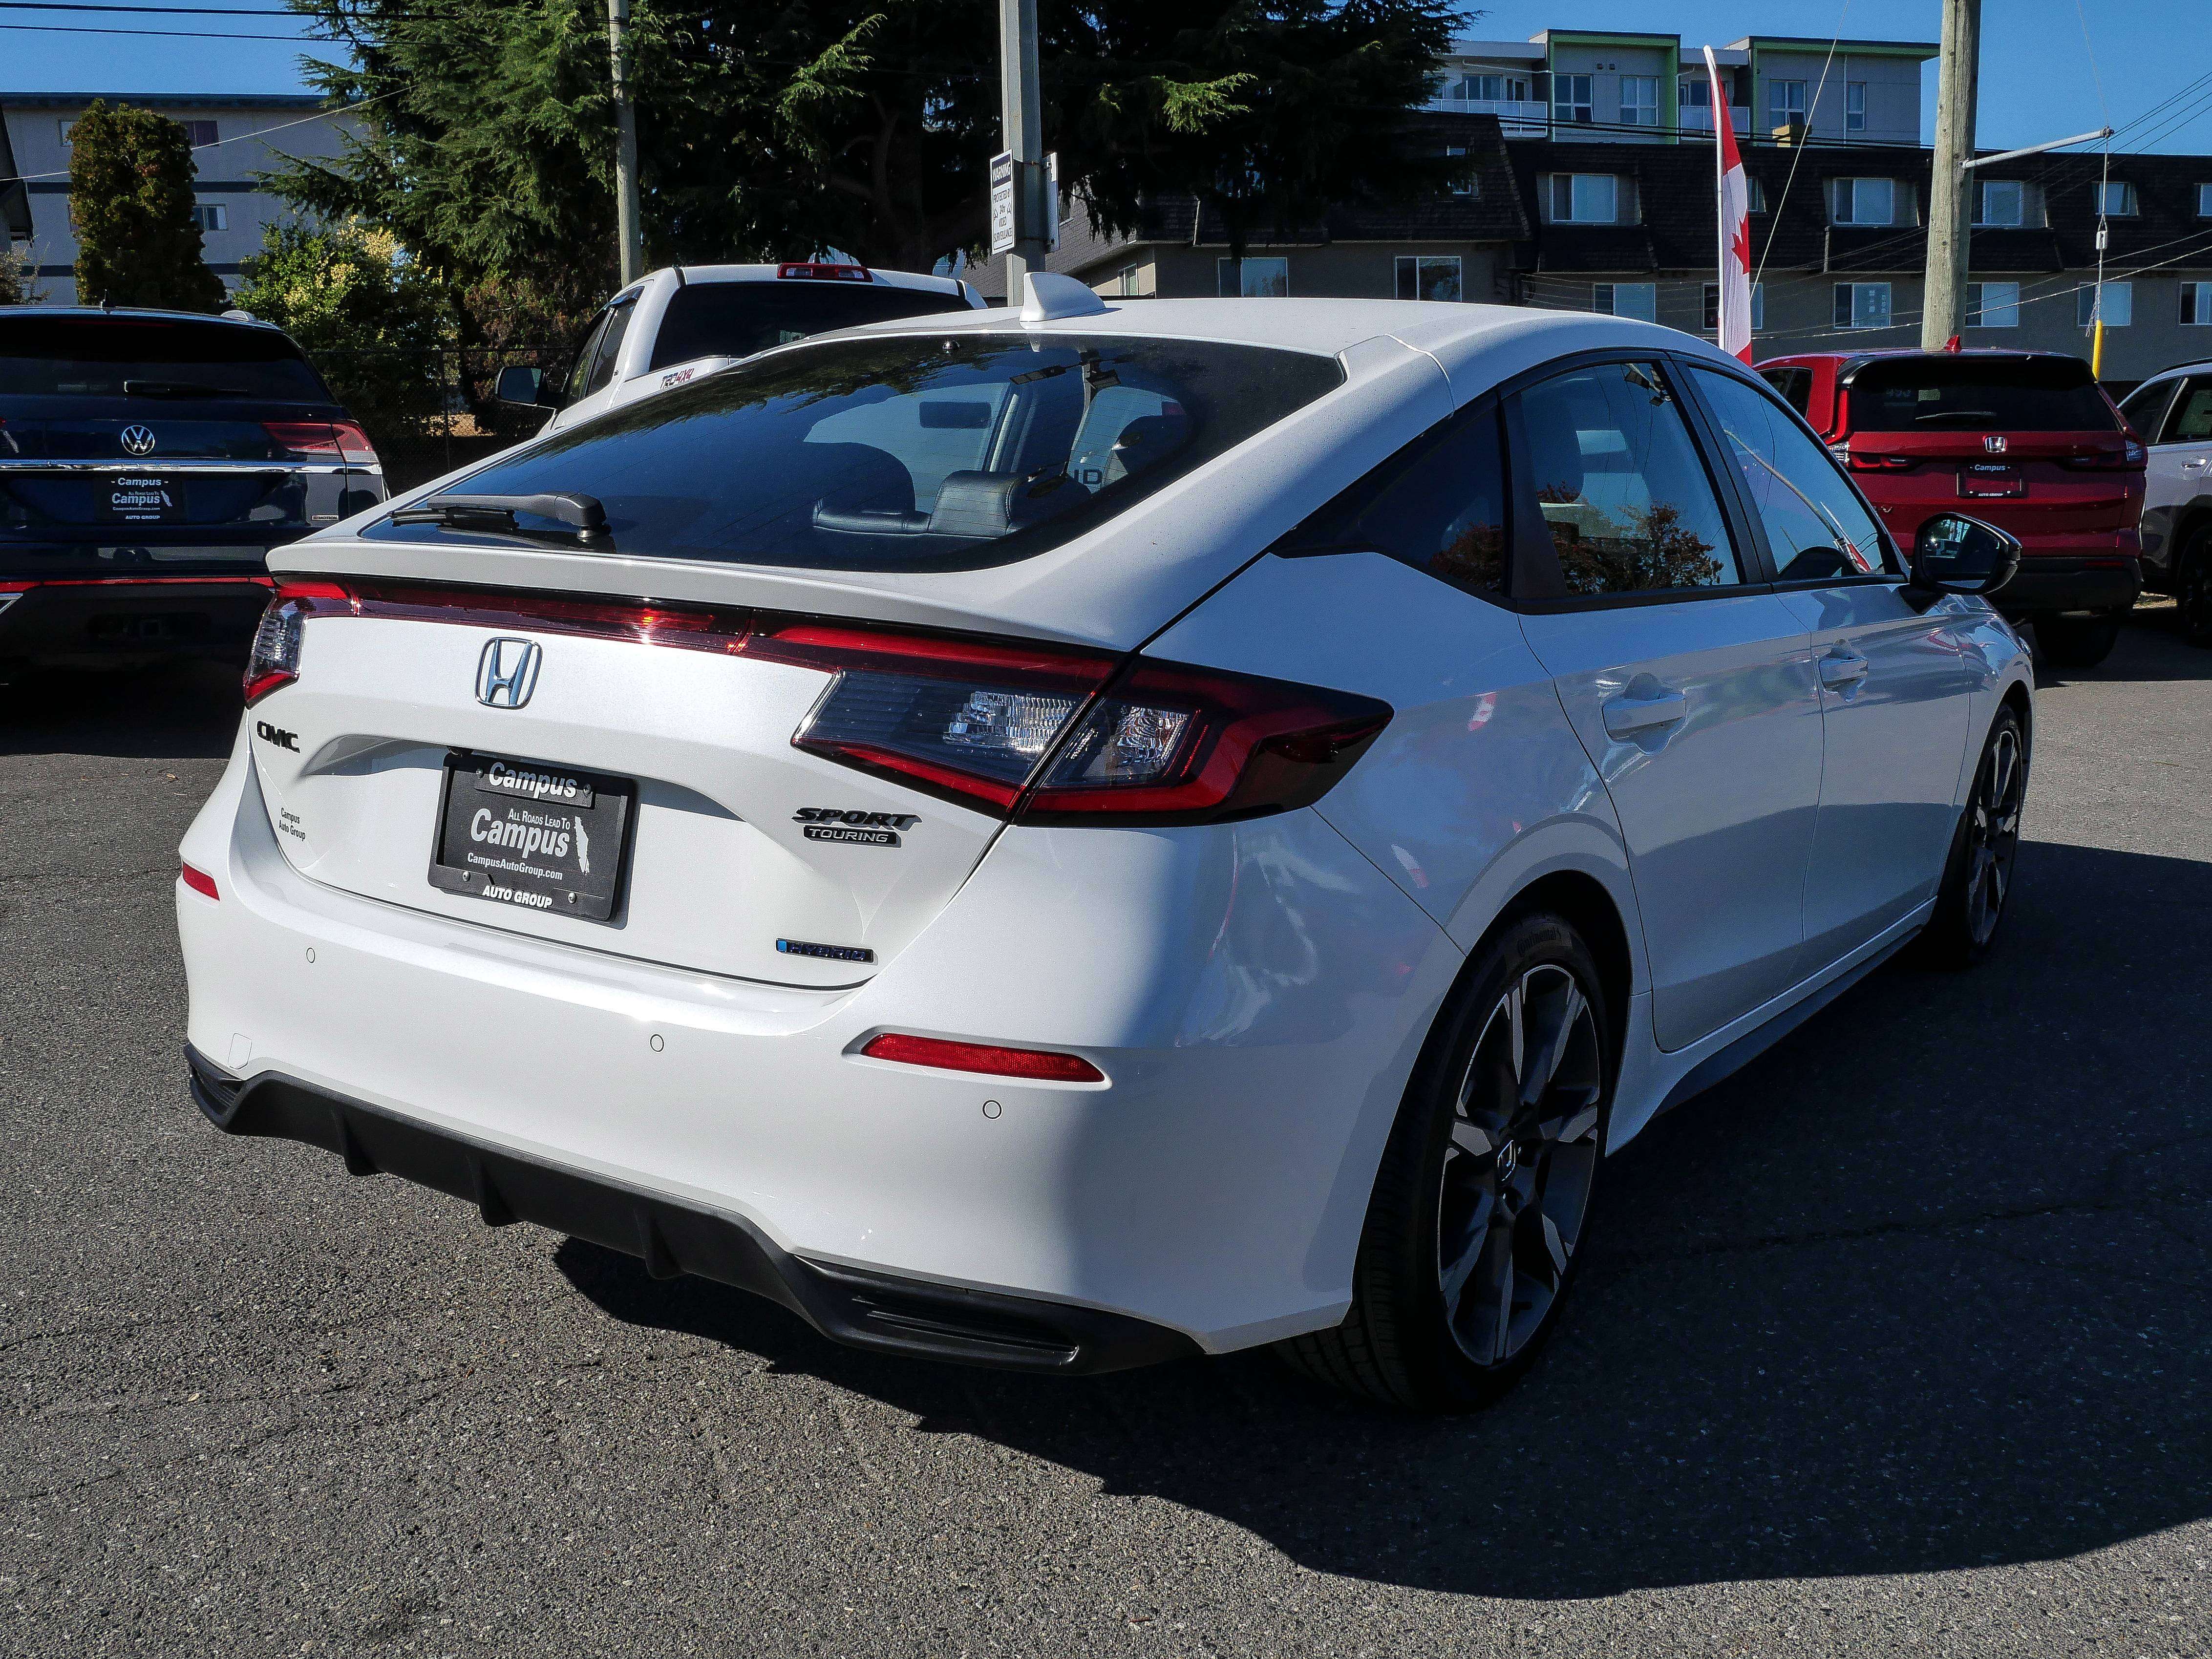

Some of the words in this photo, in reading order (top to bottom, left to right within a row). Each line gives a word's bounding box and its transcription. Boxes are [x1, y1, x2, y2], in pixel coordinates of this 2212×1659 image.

[993, 161, 1010, 182] WARNING
[118, 477, 162, 487] Campus
[112, 492, 160, 506] Campus
[488, 762, 577, 799] Campus
[281, 808, 300, 824] Campus
[508, 808, 520, 821] ALL
[522, 810, 543, 825] ROADS
[545, 814, 561, 828] LEAD
[791, 807, 923, 831] SPORT
[279, 820, 289, 833] Auto
[290, 825, 306, 841] Group
[470, 808, 571, 859] Campus
[809, 829, 889, 842] TOURING
[468, 852, 563, 880] CampusAutoGroup.com
[482, 885, 512, 902] AUTO
[514, 890, 553, 908] GROUP
